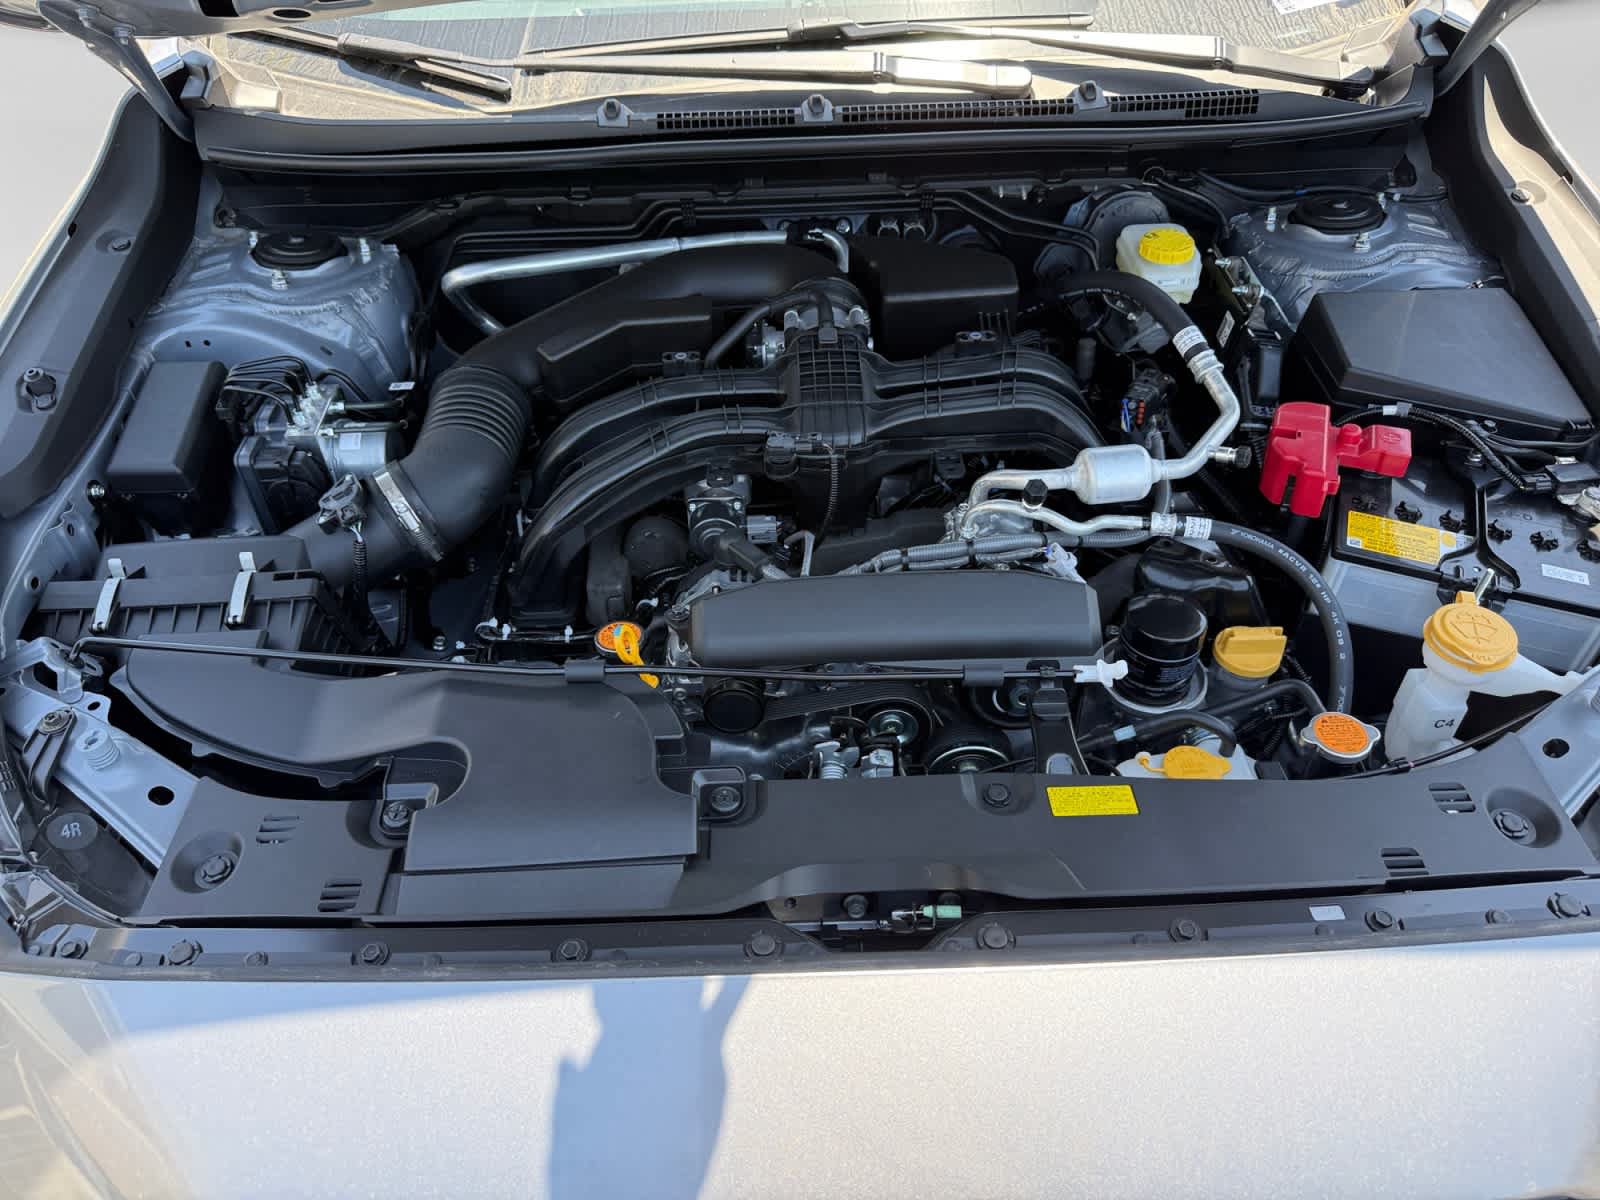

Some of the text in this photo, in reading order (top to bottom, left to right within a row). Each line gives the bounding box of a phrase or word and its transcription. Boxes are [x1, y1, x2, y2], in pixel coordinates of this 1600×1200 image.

[1240, 531, 1274, 549] YOKOHAMA
[1434, 719, 1455, 729] C4
[60, 822, 82, 839] 4R
